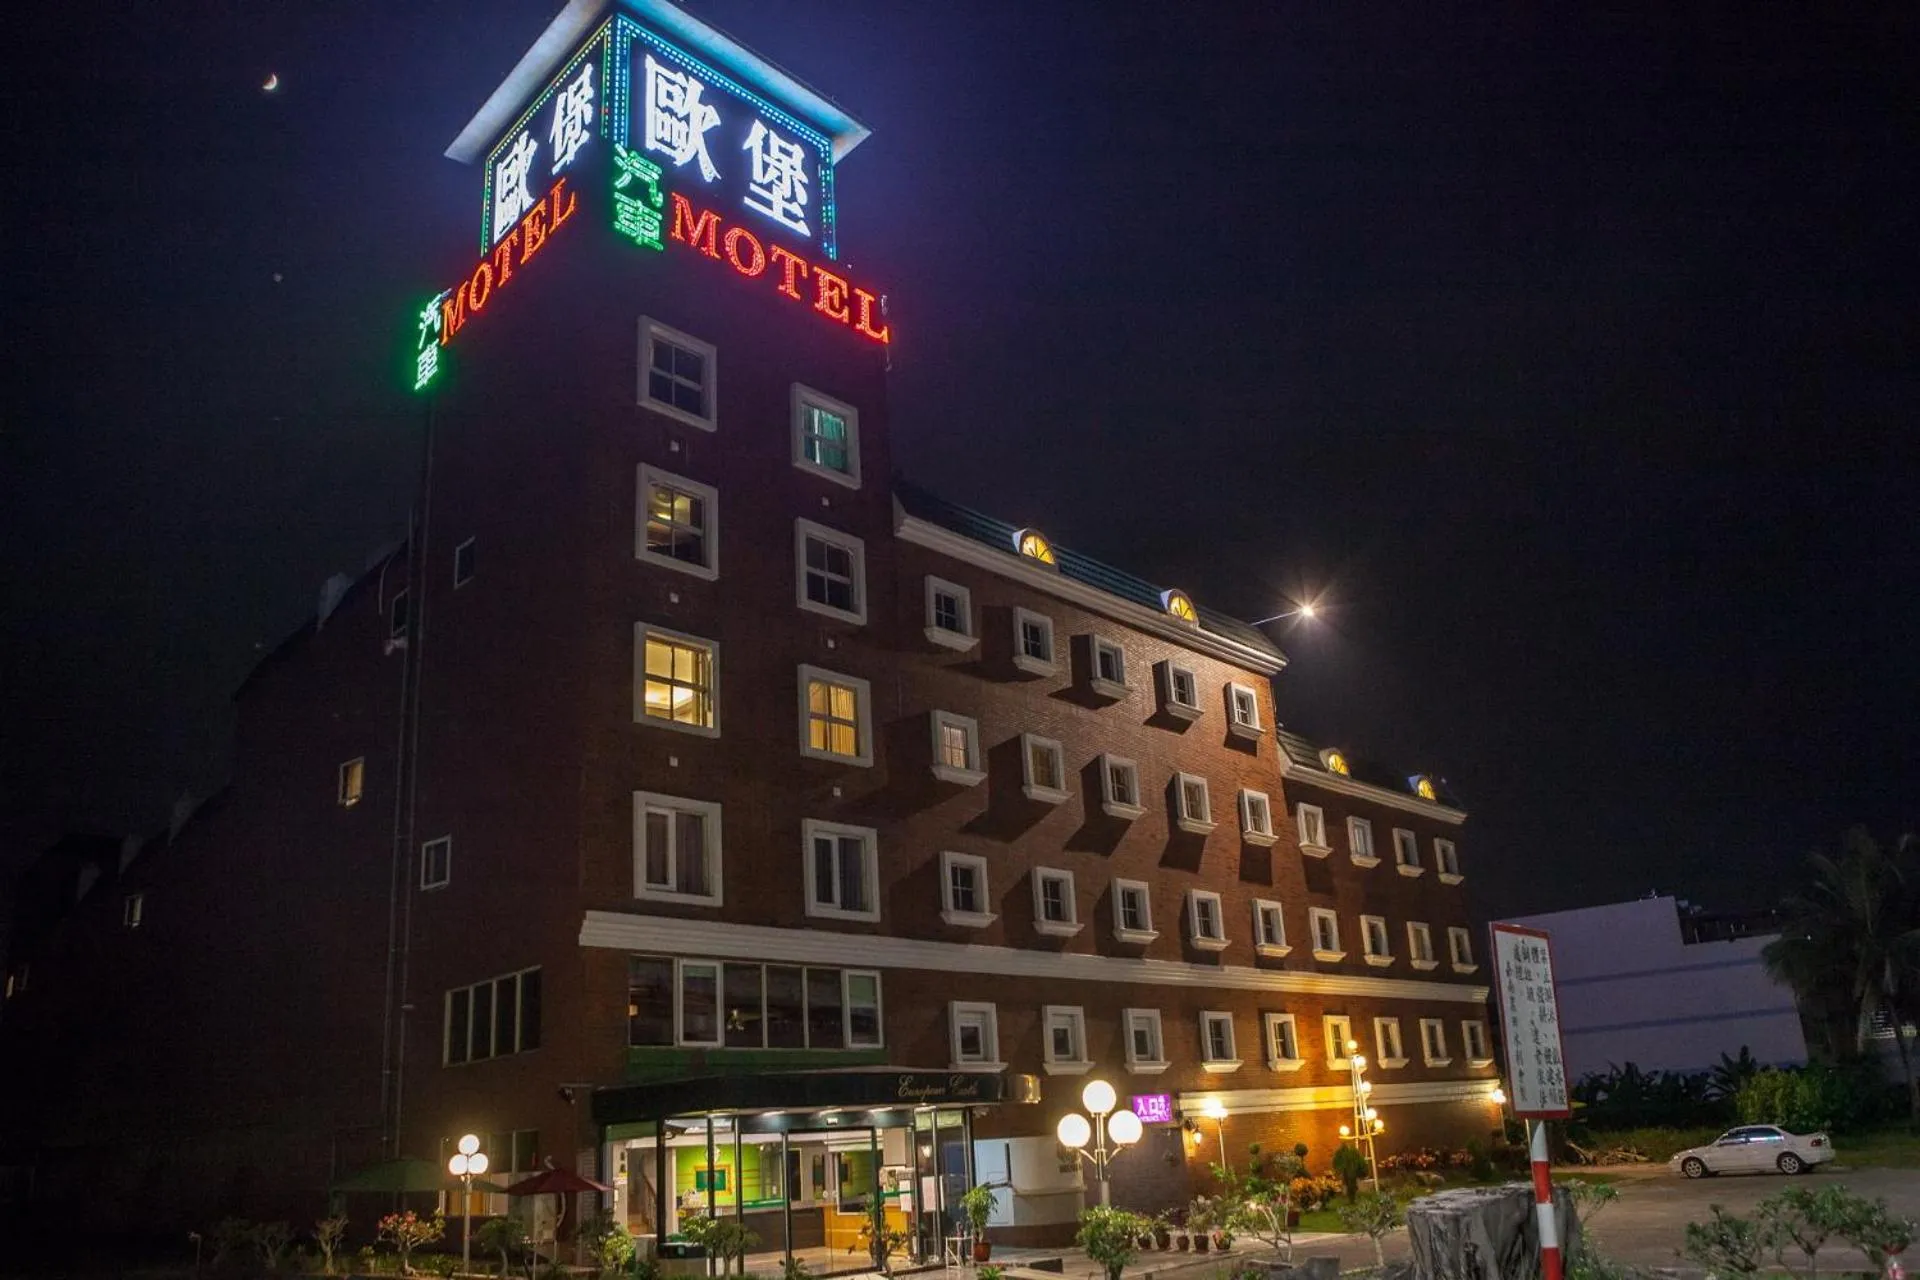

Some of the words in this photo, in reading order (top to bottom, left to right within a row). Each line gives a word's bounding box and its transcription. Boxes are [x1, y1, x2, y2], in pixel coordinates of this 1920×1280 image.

[645, 54, 811, 237] 歐堡
[440, 177, 577, 346] MOTEL
[671, 191, 889, 344] MOTEL
